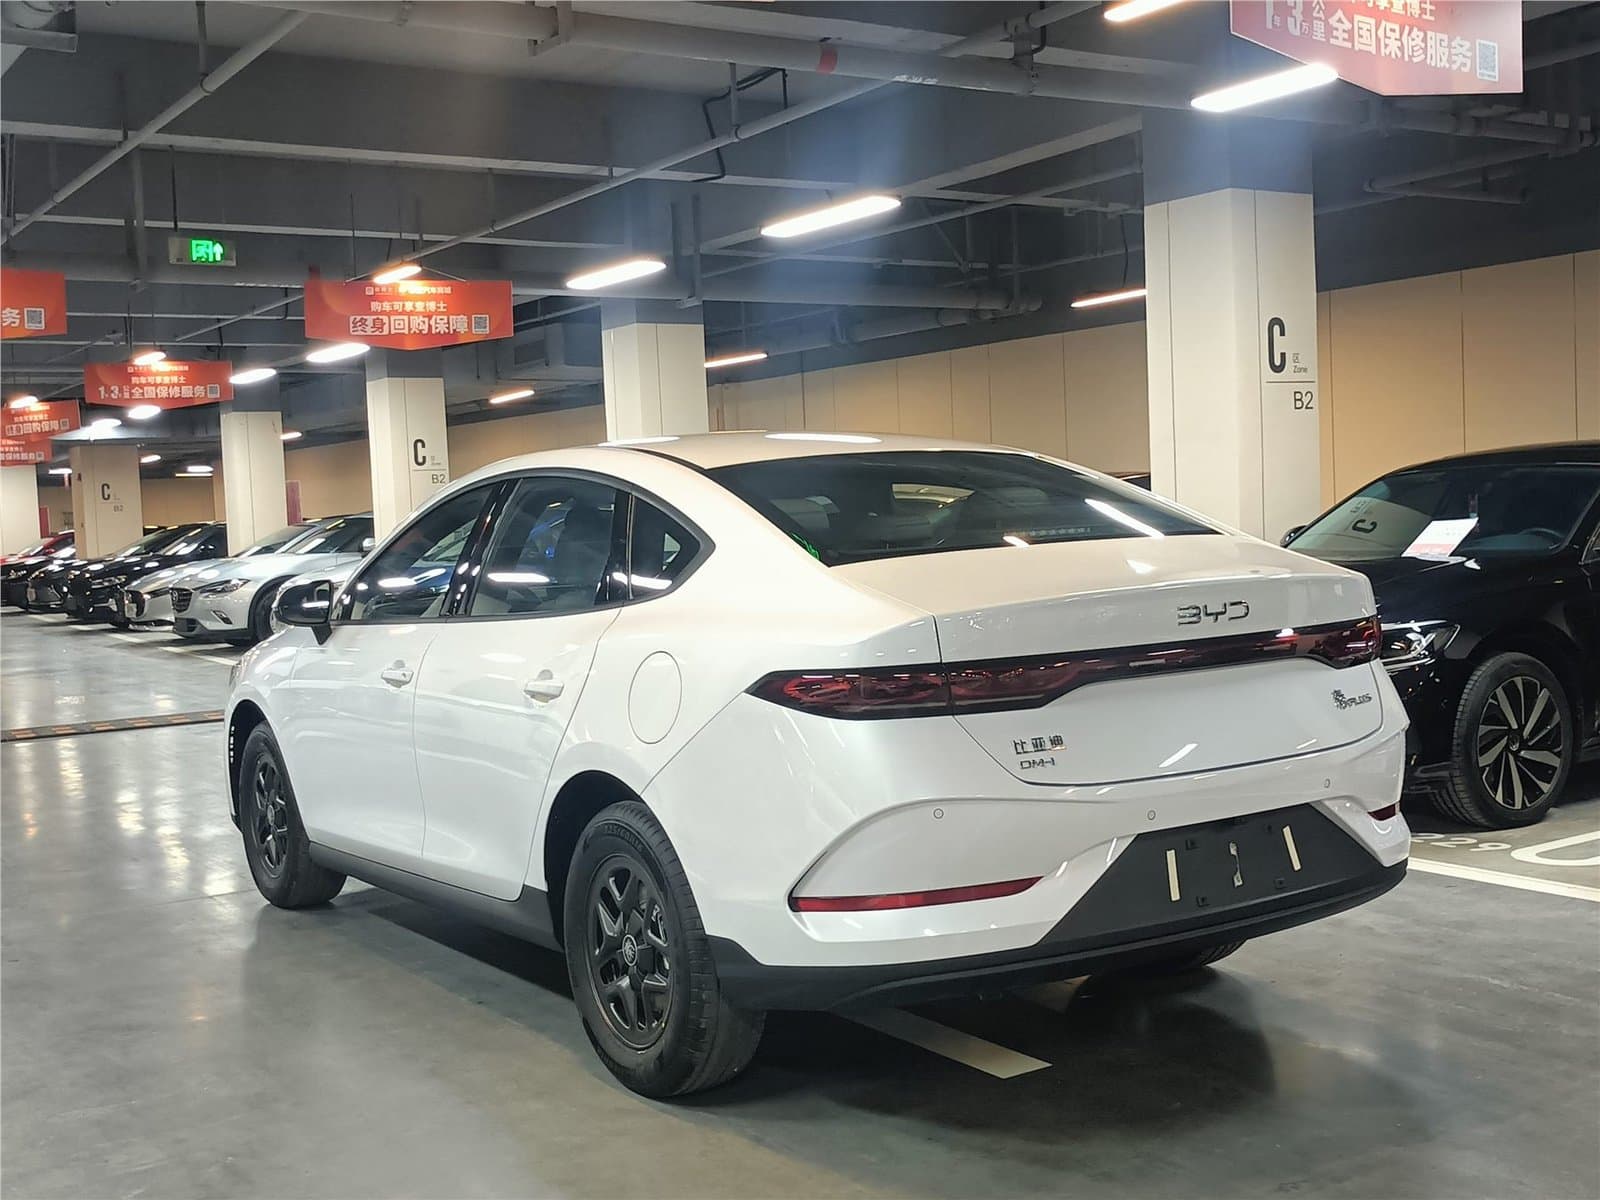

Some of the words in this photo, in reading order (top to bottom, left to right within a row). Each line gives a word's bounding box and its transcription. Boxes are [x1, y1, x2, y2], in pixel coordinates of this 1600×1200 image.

[351, 314, 468, 335] 终身回购保障
[1268, 317, 1286, 373] C
[1293, 391, 1314, 410] B2
[413, 439, 427, 466] C
[431, 473, 446, 484] B2
[101, 483, 111, 500] C
[1177, 600, 1249, 625] BYD
[1013, 735, 1066, 755] 比亚迪
